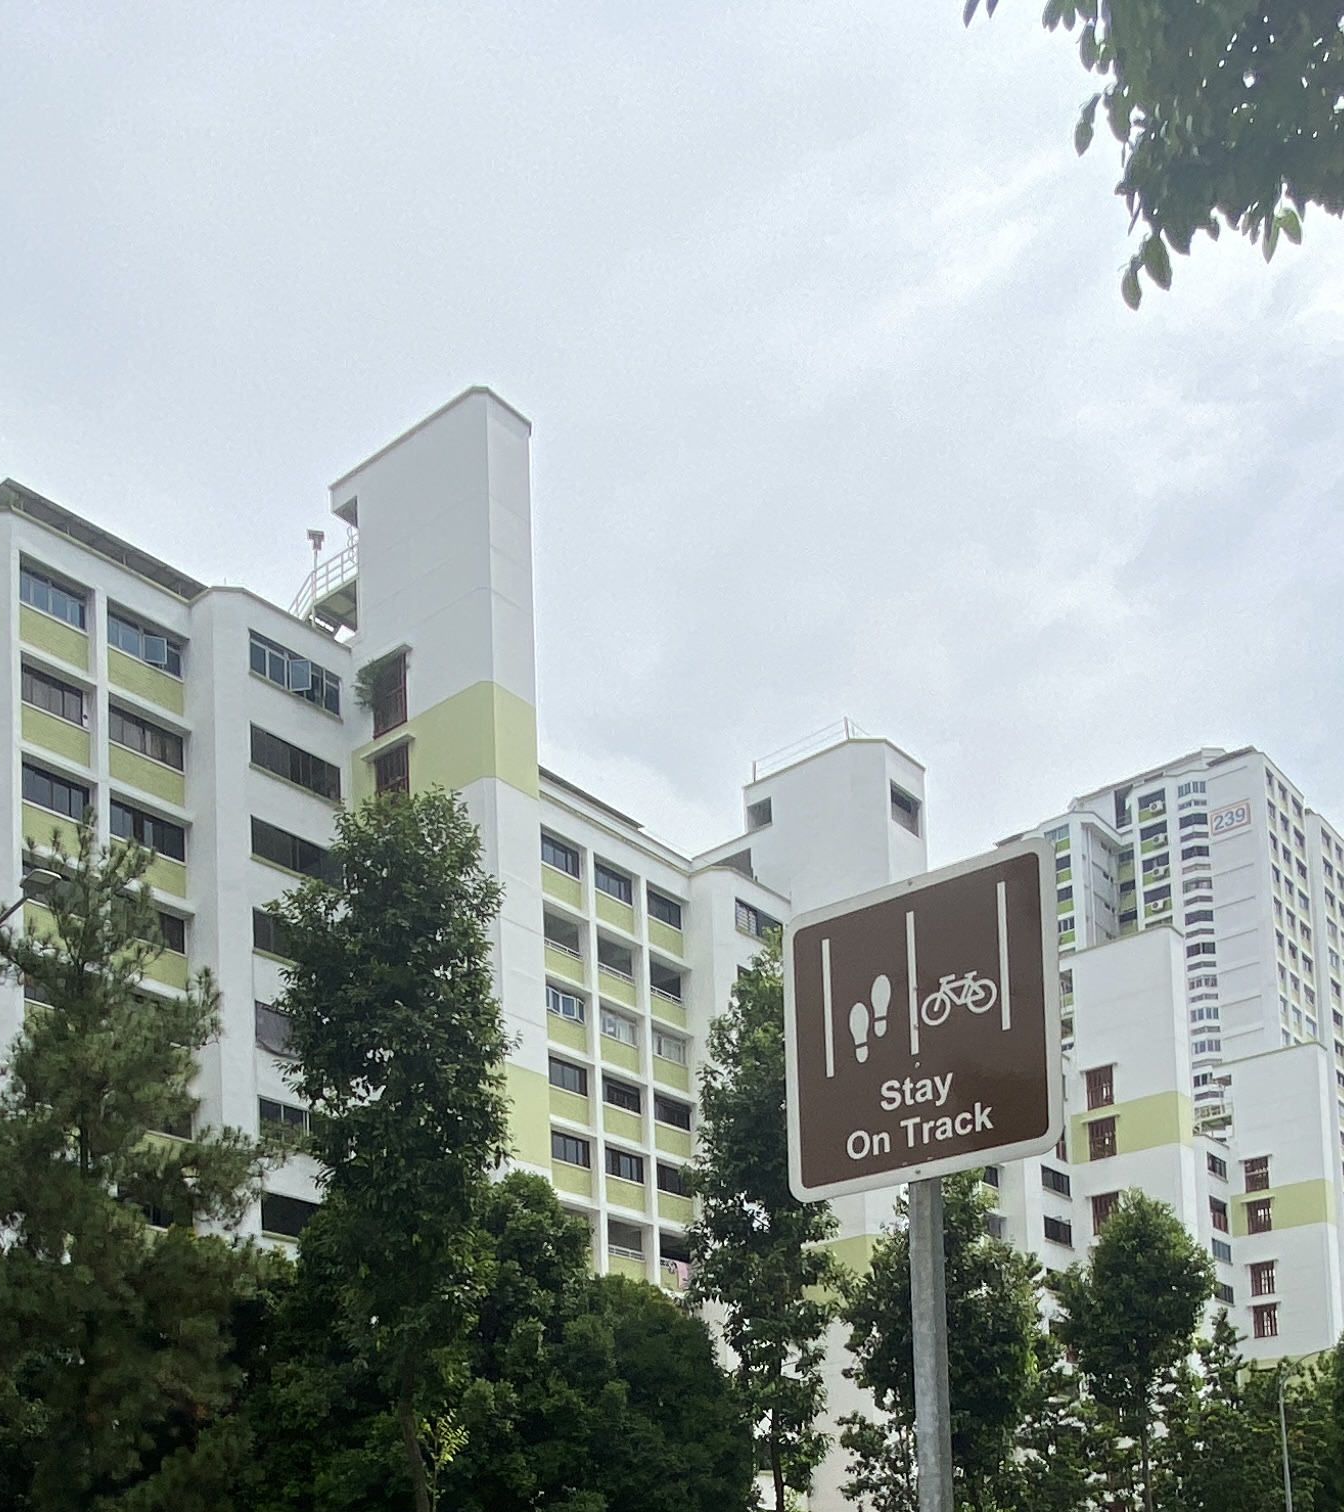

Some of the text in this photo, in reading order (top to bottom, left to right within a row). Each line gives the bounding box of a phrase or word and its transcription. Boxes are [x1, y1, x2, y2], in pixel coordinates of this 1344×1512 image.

[1213, 807, 1246, 831] 239
[879, 1072, 954, 1112] Stay
[846, 1101, 994, 1160] On Track
